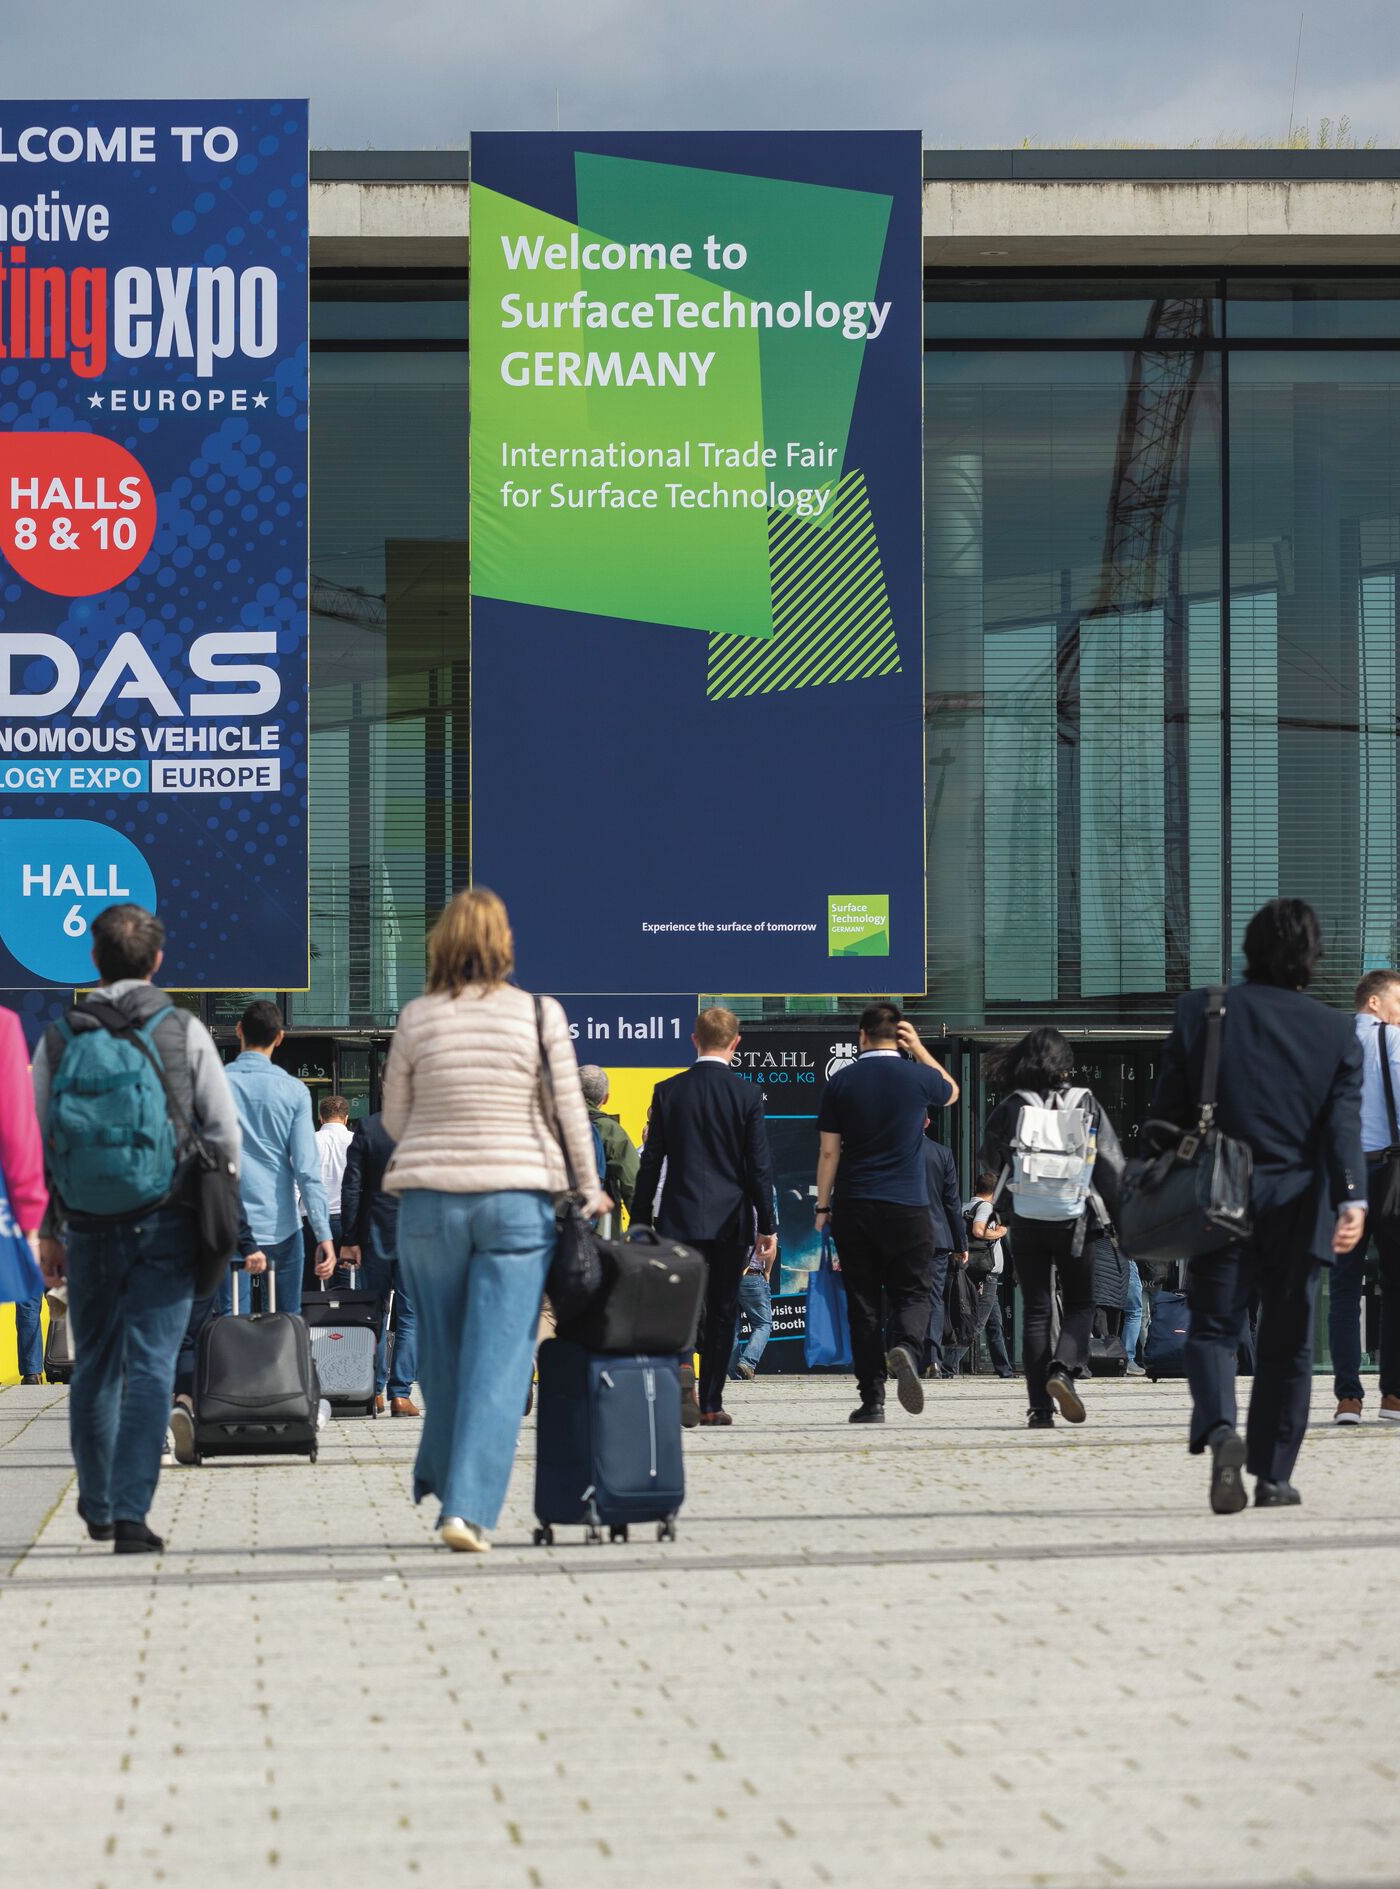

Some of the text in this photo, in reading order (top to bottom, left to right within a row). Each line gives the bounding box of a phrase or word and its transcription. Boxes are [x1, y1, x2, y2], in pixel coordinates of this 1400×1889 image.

[171, 126, 239, 163] TO
[501, 233, 748, 271] Welcome to
[500, 290, 892, 340] SurfaceTechnology
[500, 351, 716, 387] GERMANY
[111, 390, 248, 411] EUROPE
[502, 441, 838, 468] International Trade Fair
[10, 476, 141, 510] HALLS
[500, 481, 831, 516] for Surface Technology
[14, 517, 137, 551] 8 & 10
[141, 726, 280, 751] VEHICLE
[69, 766, 142, 788] EXPO
[161, 766, 271, 788] EUROPE
[21, 864, 130, 897] HALL
[831, 903, 868, 912] Surface
[831, 914, 887, 926] Technology
[62, 904, 87, 938] 6
[642, 922, 817, 934] Experience the surface of tomorrow
[587, 1016, 610, 1040] in
[618, 1016, 664, 1039] hall
[670, 1017, 680, 1039] 1
[730, 1051, 816, 1068] STAHL
[756, 1072, 765, 1083] &
[768, 1072, 792, 1083] CO.
[796, 1072, 816, 1083] KG
[770, 1304, 808, 1317] visit us
[772, 1318, 806, 1331] Booth
